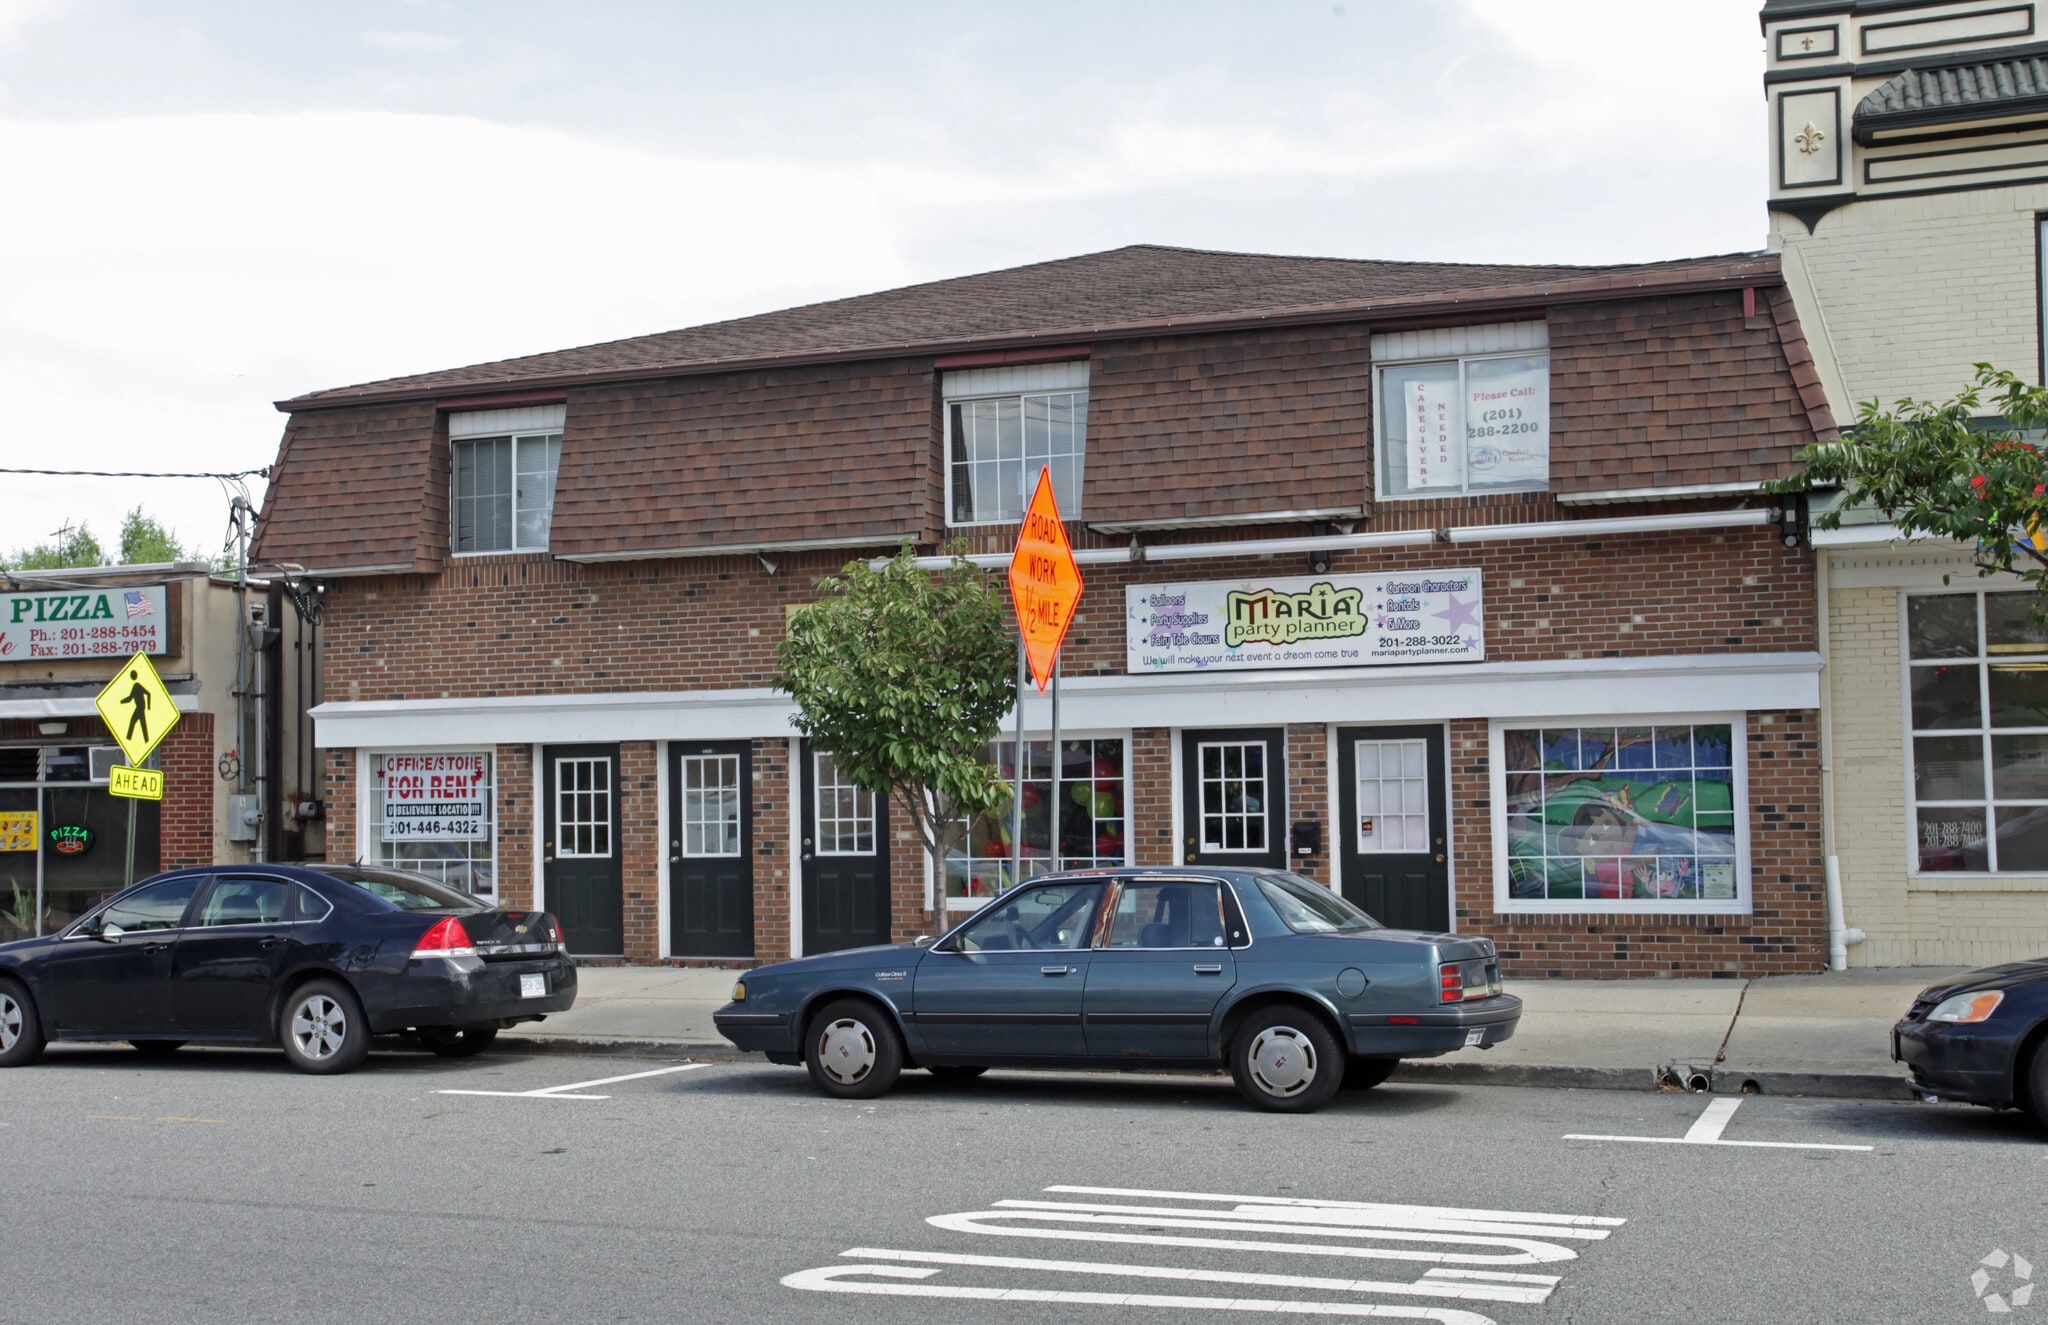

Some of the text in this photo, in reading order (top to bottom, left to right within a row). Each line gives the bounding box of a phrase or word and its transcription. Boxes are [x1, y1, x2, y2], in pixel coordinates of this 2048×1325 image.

[1473, 387, 1536, 401] Please Call:
[1482, 408, 1522, 423] (201)
[1417, 384, 1428, 485] CAREGIVERS
[1437, 402, 1448, 463] NEEDED
[1468, 422, 1539, 438] 288-2200
[1031, 513, 1056, 545] ROAD
[1029, 554, 1057, 586] WORK
[1386, 580, 1467, 594] Cartoon Characters
[10, 594, 114, 623] PIZZA
[1150, 594, 1185, 607] Balloons
[1387, 598, 1420, 612] Rentals
[1038, 599, 1059, 627] MILE
[1151, 612, 1208, 628] Party Supplies
[1234, 619, 1356, 638] party planner
[1387, 617, 1420, 631] & More
[30, 625, 157, 641] Ph.: 201-288-5454
[1151, 632, 1220, 649] Fairy Tale Clowns
[30, 640, 157, 656] Fax: 201-288-7979
[1379, 635, 1460, 648] 201-288-3022
[1143, 655, 1158, 665] We
[1161, 655, 1175, 664] will
[1178, 654, 1201, 663] make
[1203, 655, 1222, 666] your
[1247, 652, 1272, 661] event
[1283, 650, 1312, 660] dream
[1315, 650, 1338, 658] come
[1341, 648, 1359, 658] true
[1371, 647, 1469, 657] mariapartyplanner.com
[115, 773, 158, 792] AHEAD
[388, 775, 480, 799] FOR RENT
[388, 805, 437, 816] UBELIEVABLE
[51, 827, 88, 841] PIZZA
[1924, 821, 1982, 835] 201-288-7400
